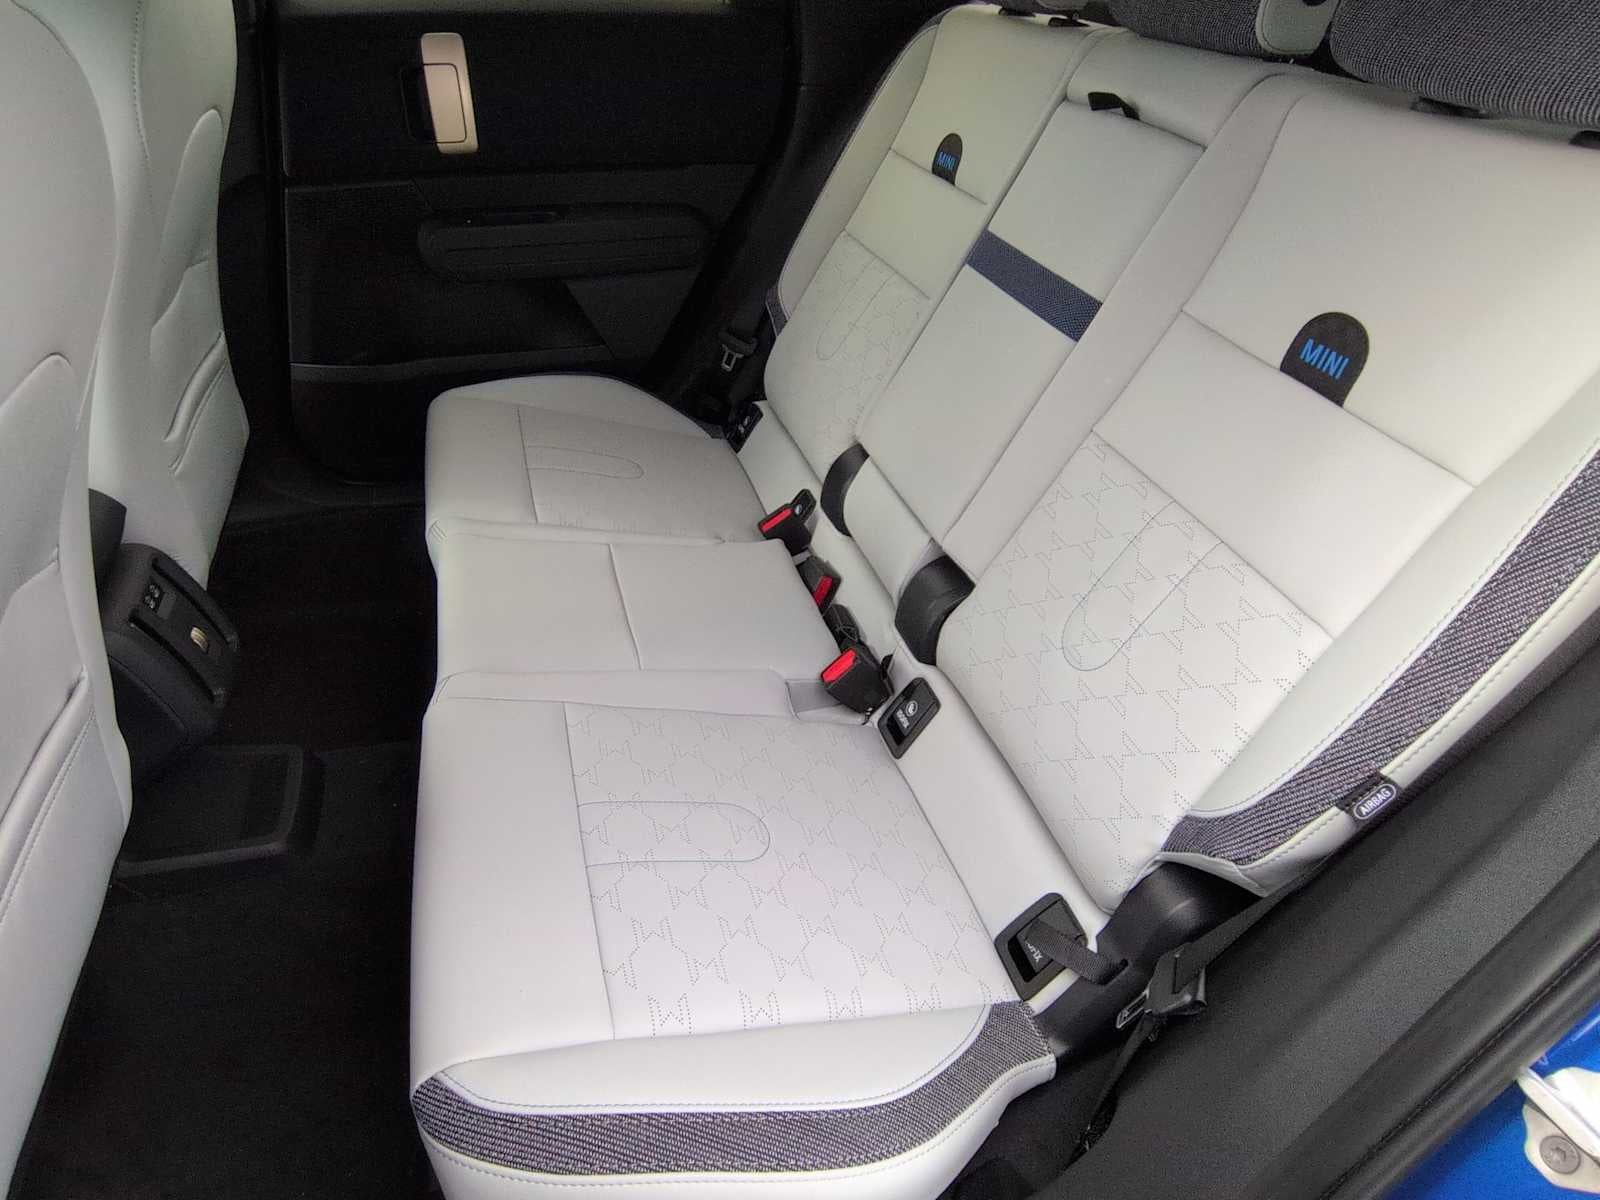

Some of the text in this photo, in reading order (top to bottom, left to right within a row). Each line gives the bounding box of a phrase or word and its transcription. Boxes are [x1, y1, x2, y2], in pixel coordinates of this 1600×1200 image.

[937, 151, 956, 170] MINI
[1300, 338, 1349, 380] MINI
[1360, 788, 1392, 816] AIRBAG
